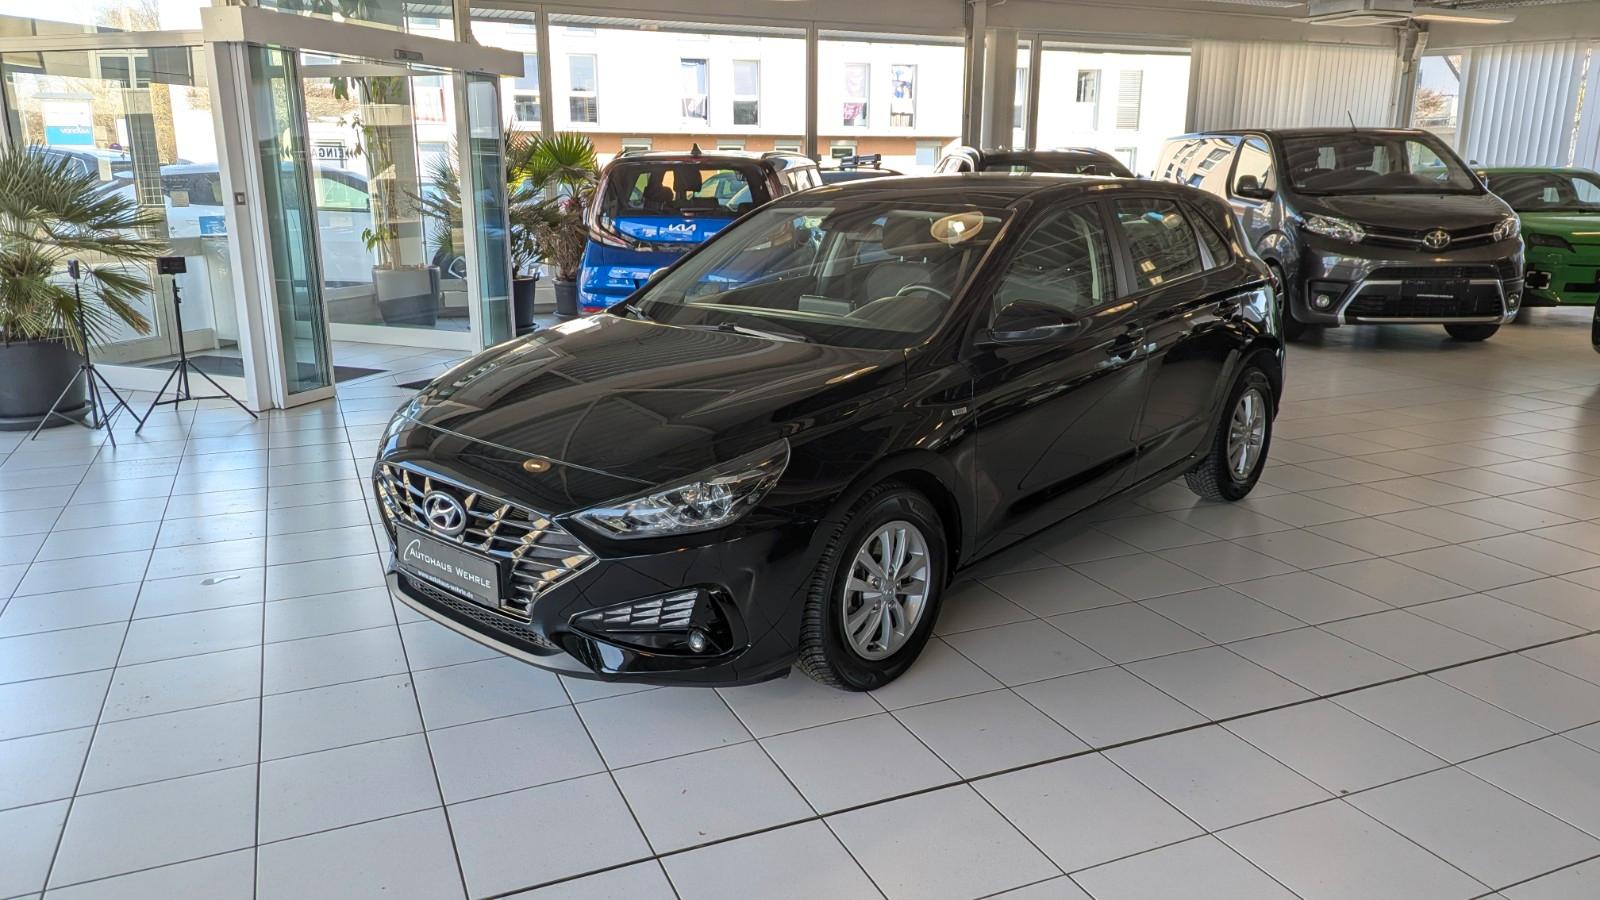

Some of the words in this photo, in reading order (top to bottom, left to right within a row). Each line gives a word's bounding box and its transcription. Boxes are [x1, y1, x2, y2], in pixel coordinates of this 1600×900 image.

[668, 223, 697, 232] KIA
[409, 547, 453, 574] AUTOHAUS
[455, 566, 491, 589] WEHRLE
